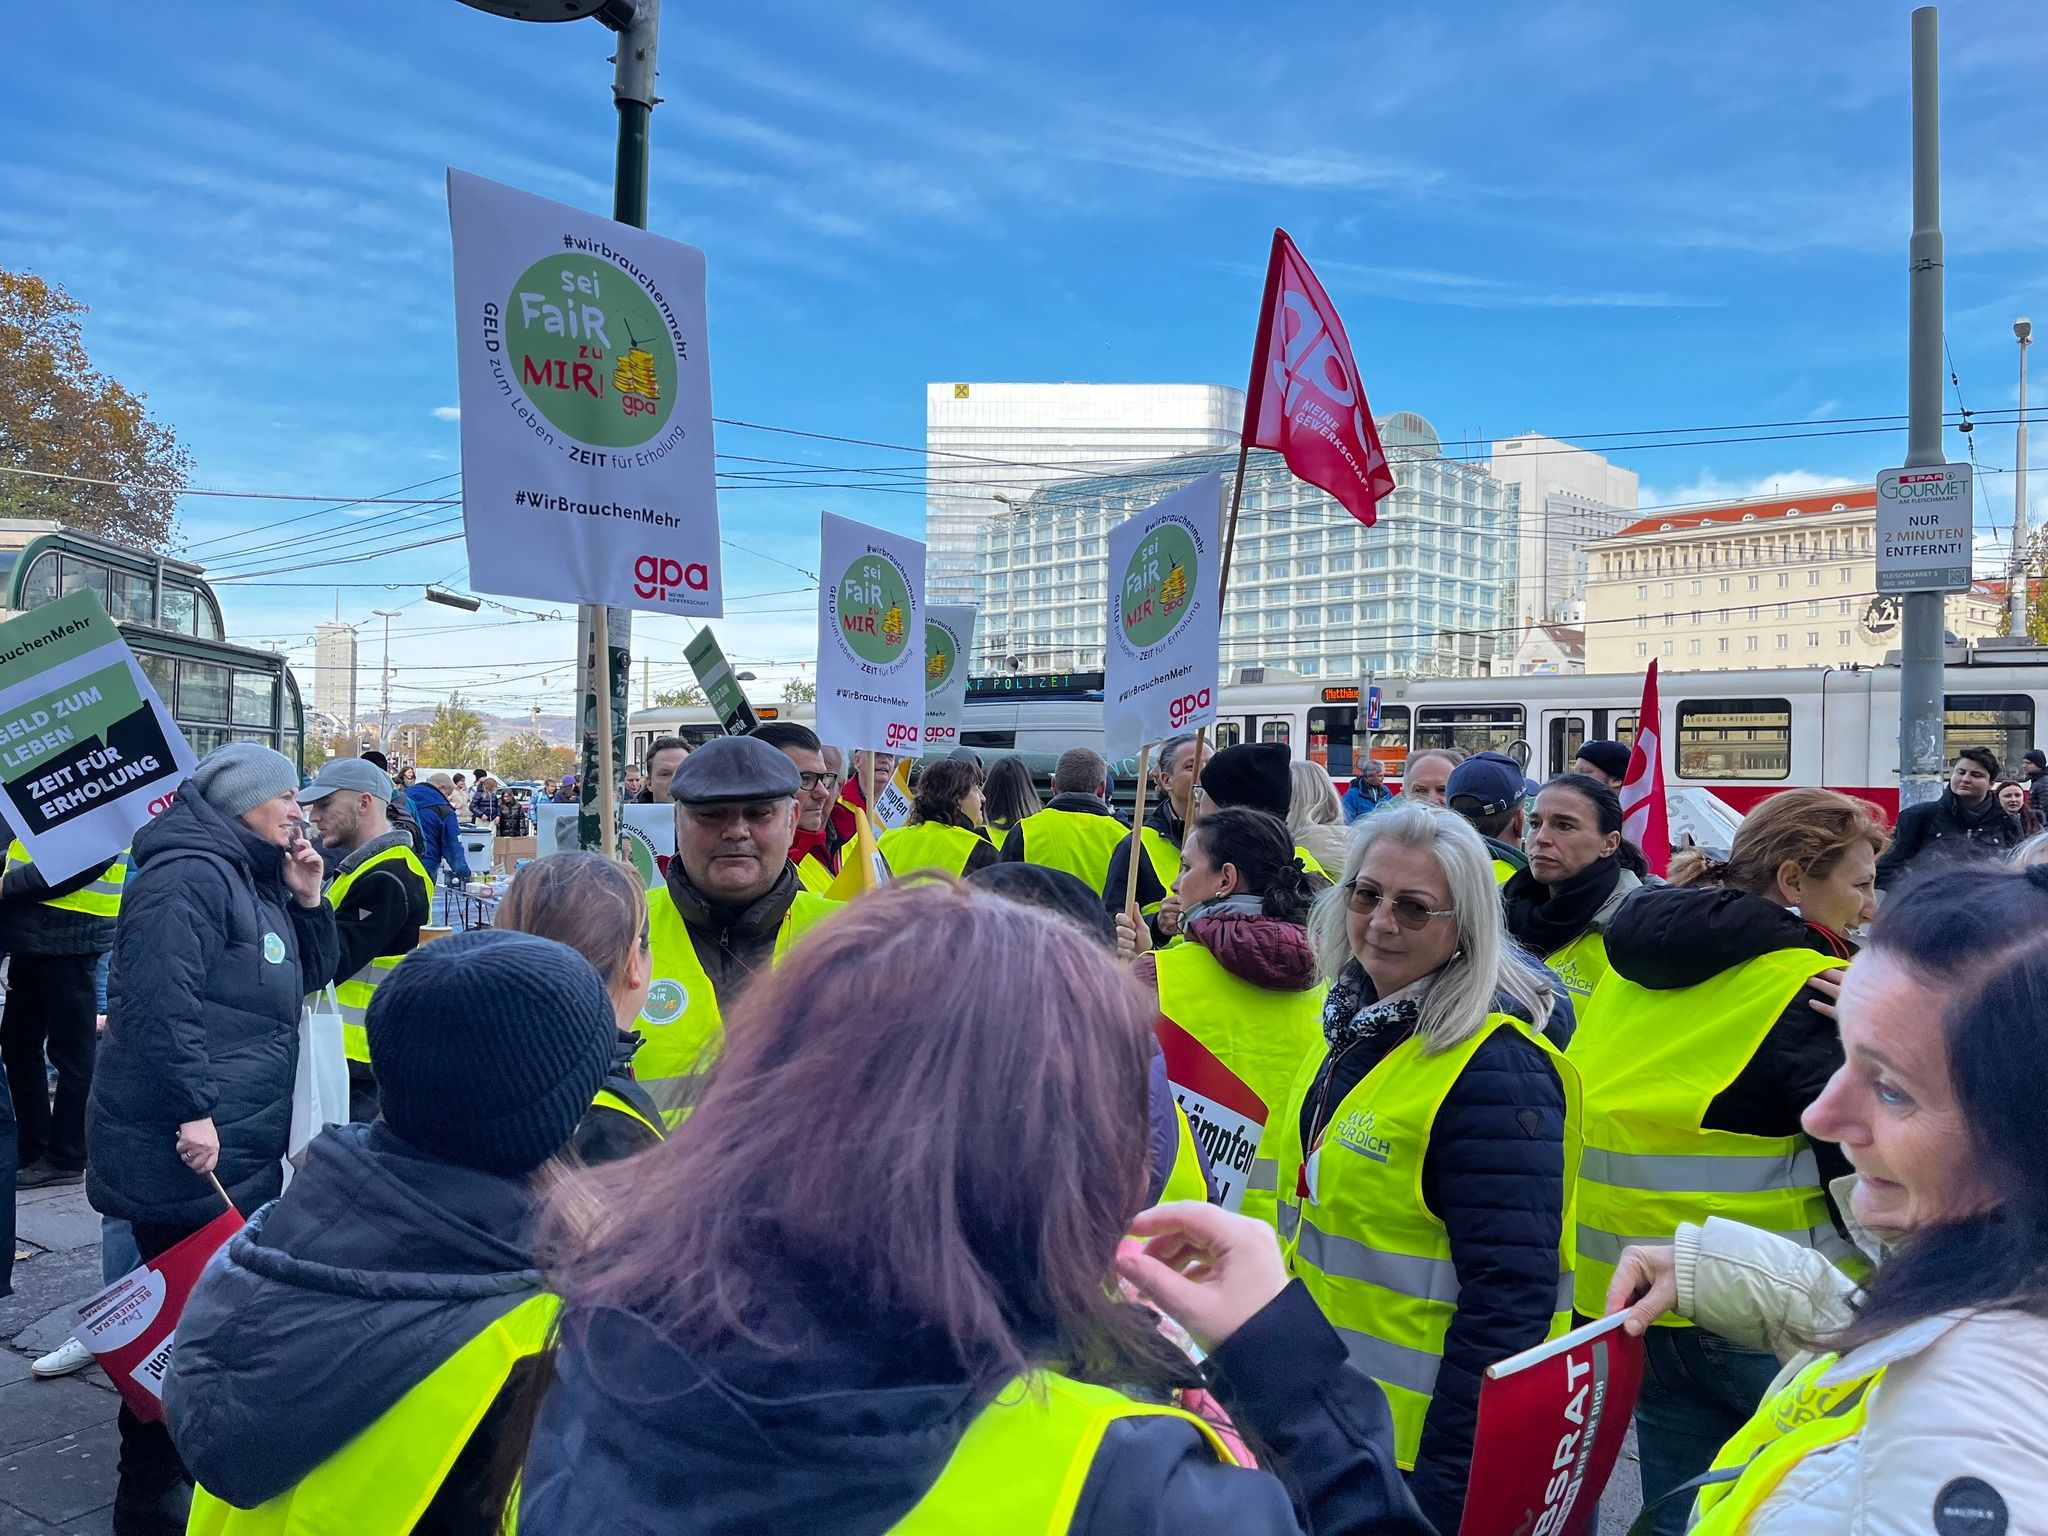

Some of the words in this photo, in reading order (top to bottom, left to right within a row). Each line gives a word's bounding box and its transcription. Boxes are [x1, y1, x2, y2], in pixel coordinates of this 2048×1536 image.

[561, 270, 600, 298] sei
[563, 233, 688, 361] #wirbrauchenmehr
[483, 302, 500, 353] GELD
[578, 345, 603, 360] zu
[489, 358, 512, 396] zum
[523, 354, 604, 399] MIR!
[621, 394, 657, 417] gpa
[1302, 399, 1339, 432] MEINE
[510, 397, 554, 446] Leben
[568, 445, 607, 468] ZEIT
[635, 424, 686, 467] Erholung
[1295, 412, 1370, 492] GEWERKSCHAF
[611, 454, 633, 469] für
[1880, 477, 1969, 499] GOURMET
[1907, 473, 1944, 482] SPAR
[515, 490, 681, 529] #WirBrauchenMehr
[1911, 495, 1959, 504] FLEISCHMARKT
[1144, 513, 1204, 555] #wirbrauchenmehr
[1909, 514, 1939, 527] NUR
[1141, 536, 1159, 561] sei
[1884, 532, 1892, 543] 2
[1897, 527, 1964, 542] MINUTEN
[1886, 543, 1962, 557] ENTFERNT!
[633, 554, 709, 601] gpa
[863, 564, 881, 581] sei
[866, 544, 917, 612] #wirbrauchenmehr
[668, 597, 710, 606] GEWERKSCHAFT
[828, 585, 837, 614] GELD
[868, 607, 880, 615] zu
[830, 616, 840, 638] zum
[885, 633, 902, 646] gpa
[1139, 649, 1154, 661] ZEIT
[1167, 601, 1201, 646] Erholung
[860, 662, 878, 676] ZEIT
[992, 675, 1070, 690] POLIZEI
[836, 687, 909, 708] #WirBrauchenMehr
[1118, 665, 1193, 703] #WirBrauchenMehr
[51, 686, 103, 719] ZUM
[1169, 687, 1210, 728] gpa
[2, 725, 75, 768] LEBEN
[885, 722, 919, 748] gpa
[924, 726, 956, 742] gpa
[26, 764, 75, 801] ZEIT
[76, 745, 124, 784] FÜR
[39, 754, 161, 820] ERHOLUNG
[622, 823, 658, 863] auchenme
[1564, 975, 1595, 992] DICH
[1355, 1130, 1391, 1155] DICH
[90, 1290, 152, 1337] BETRIEBSRAT
[1574, 1449, 1589, 1478] WIR
[1591, 1380, 1605, 1417] DICH
